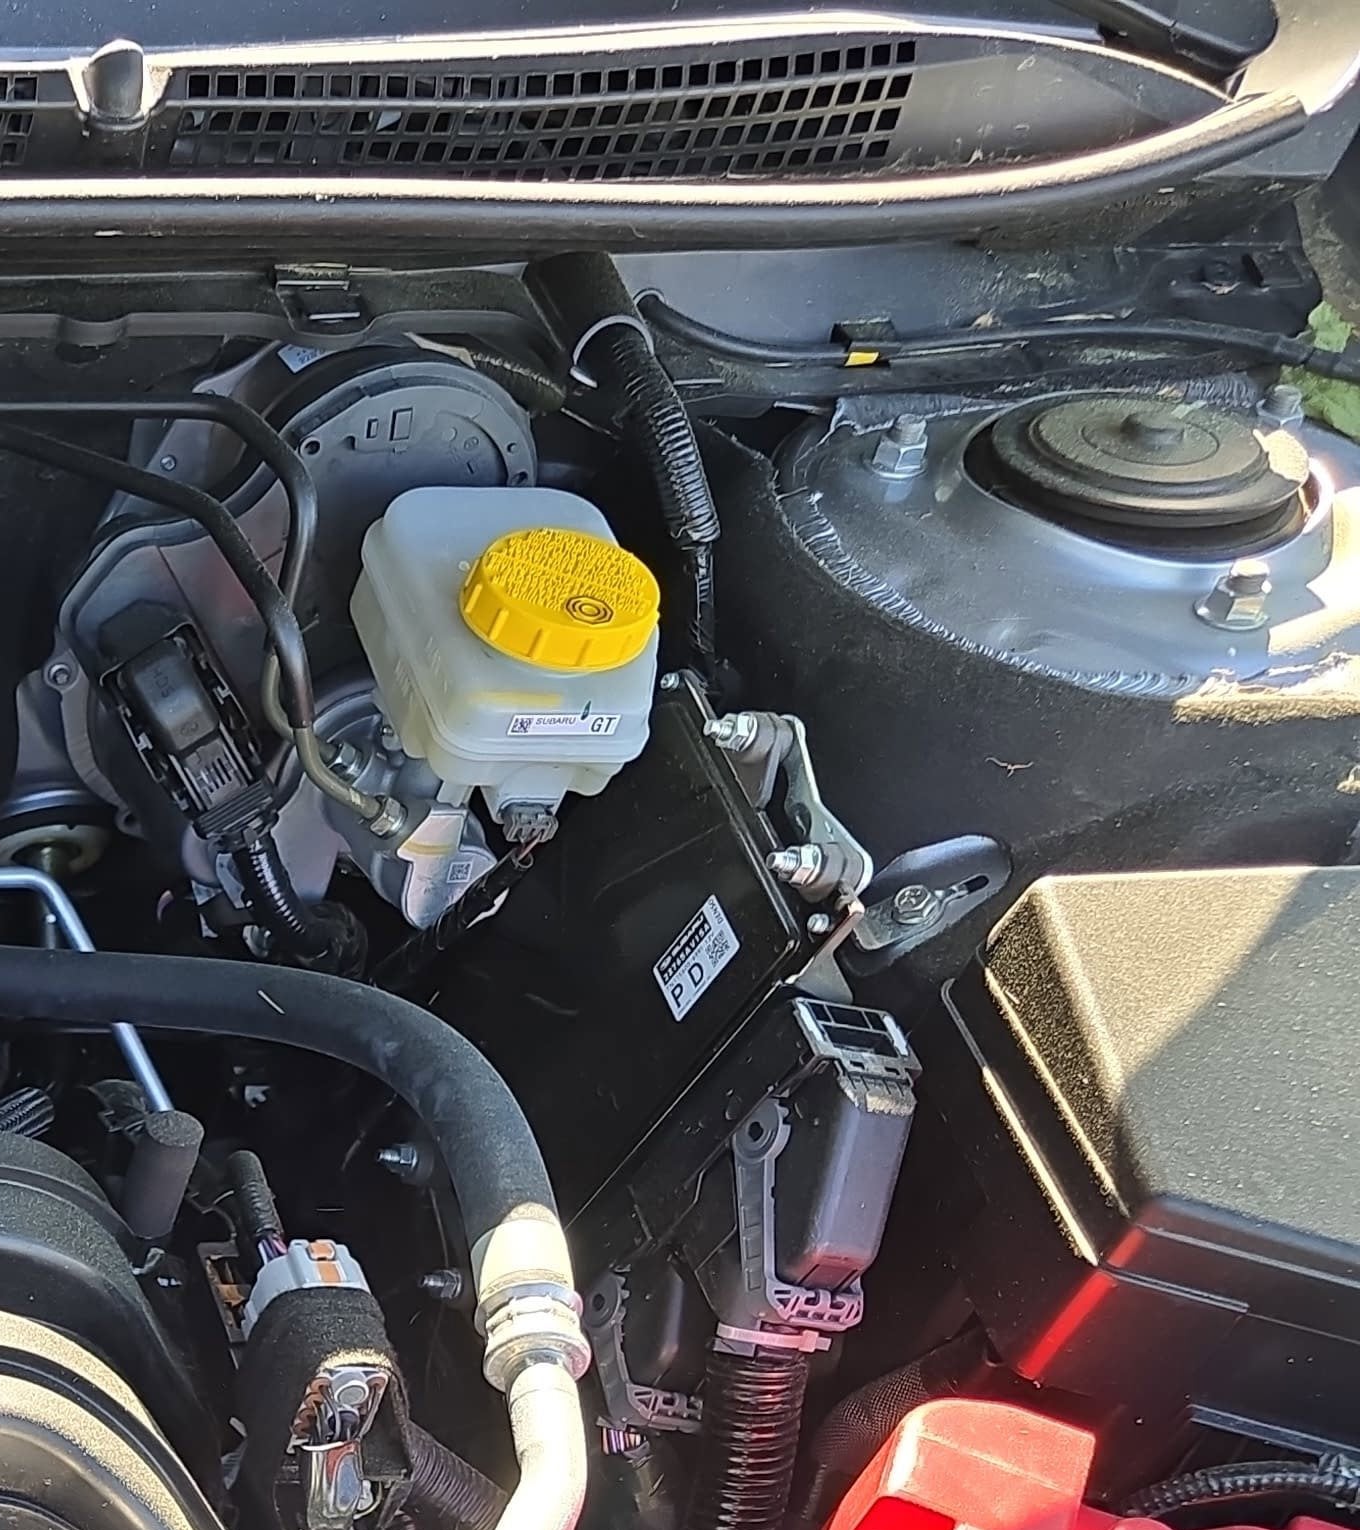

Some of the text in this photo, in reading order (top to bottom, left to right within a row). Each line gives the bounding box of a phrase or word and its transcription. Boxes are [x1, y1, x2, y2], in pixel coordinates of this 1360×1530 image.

[535, 717, 617, 733] SUBARU GT
[670, 982, 685, 1008] P
[687, 961, 704, 988] D
